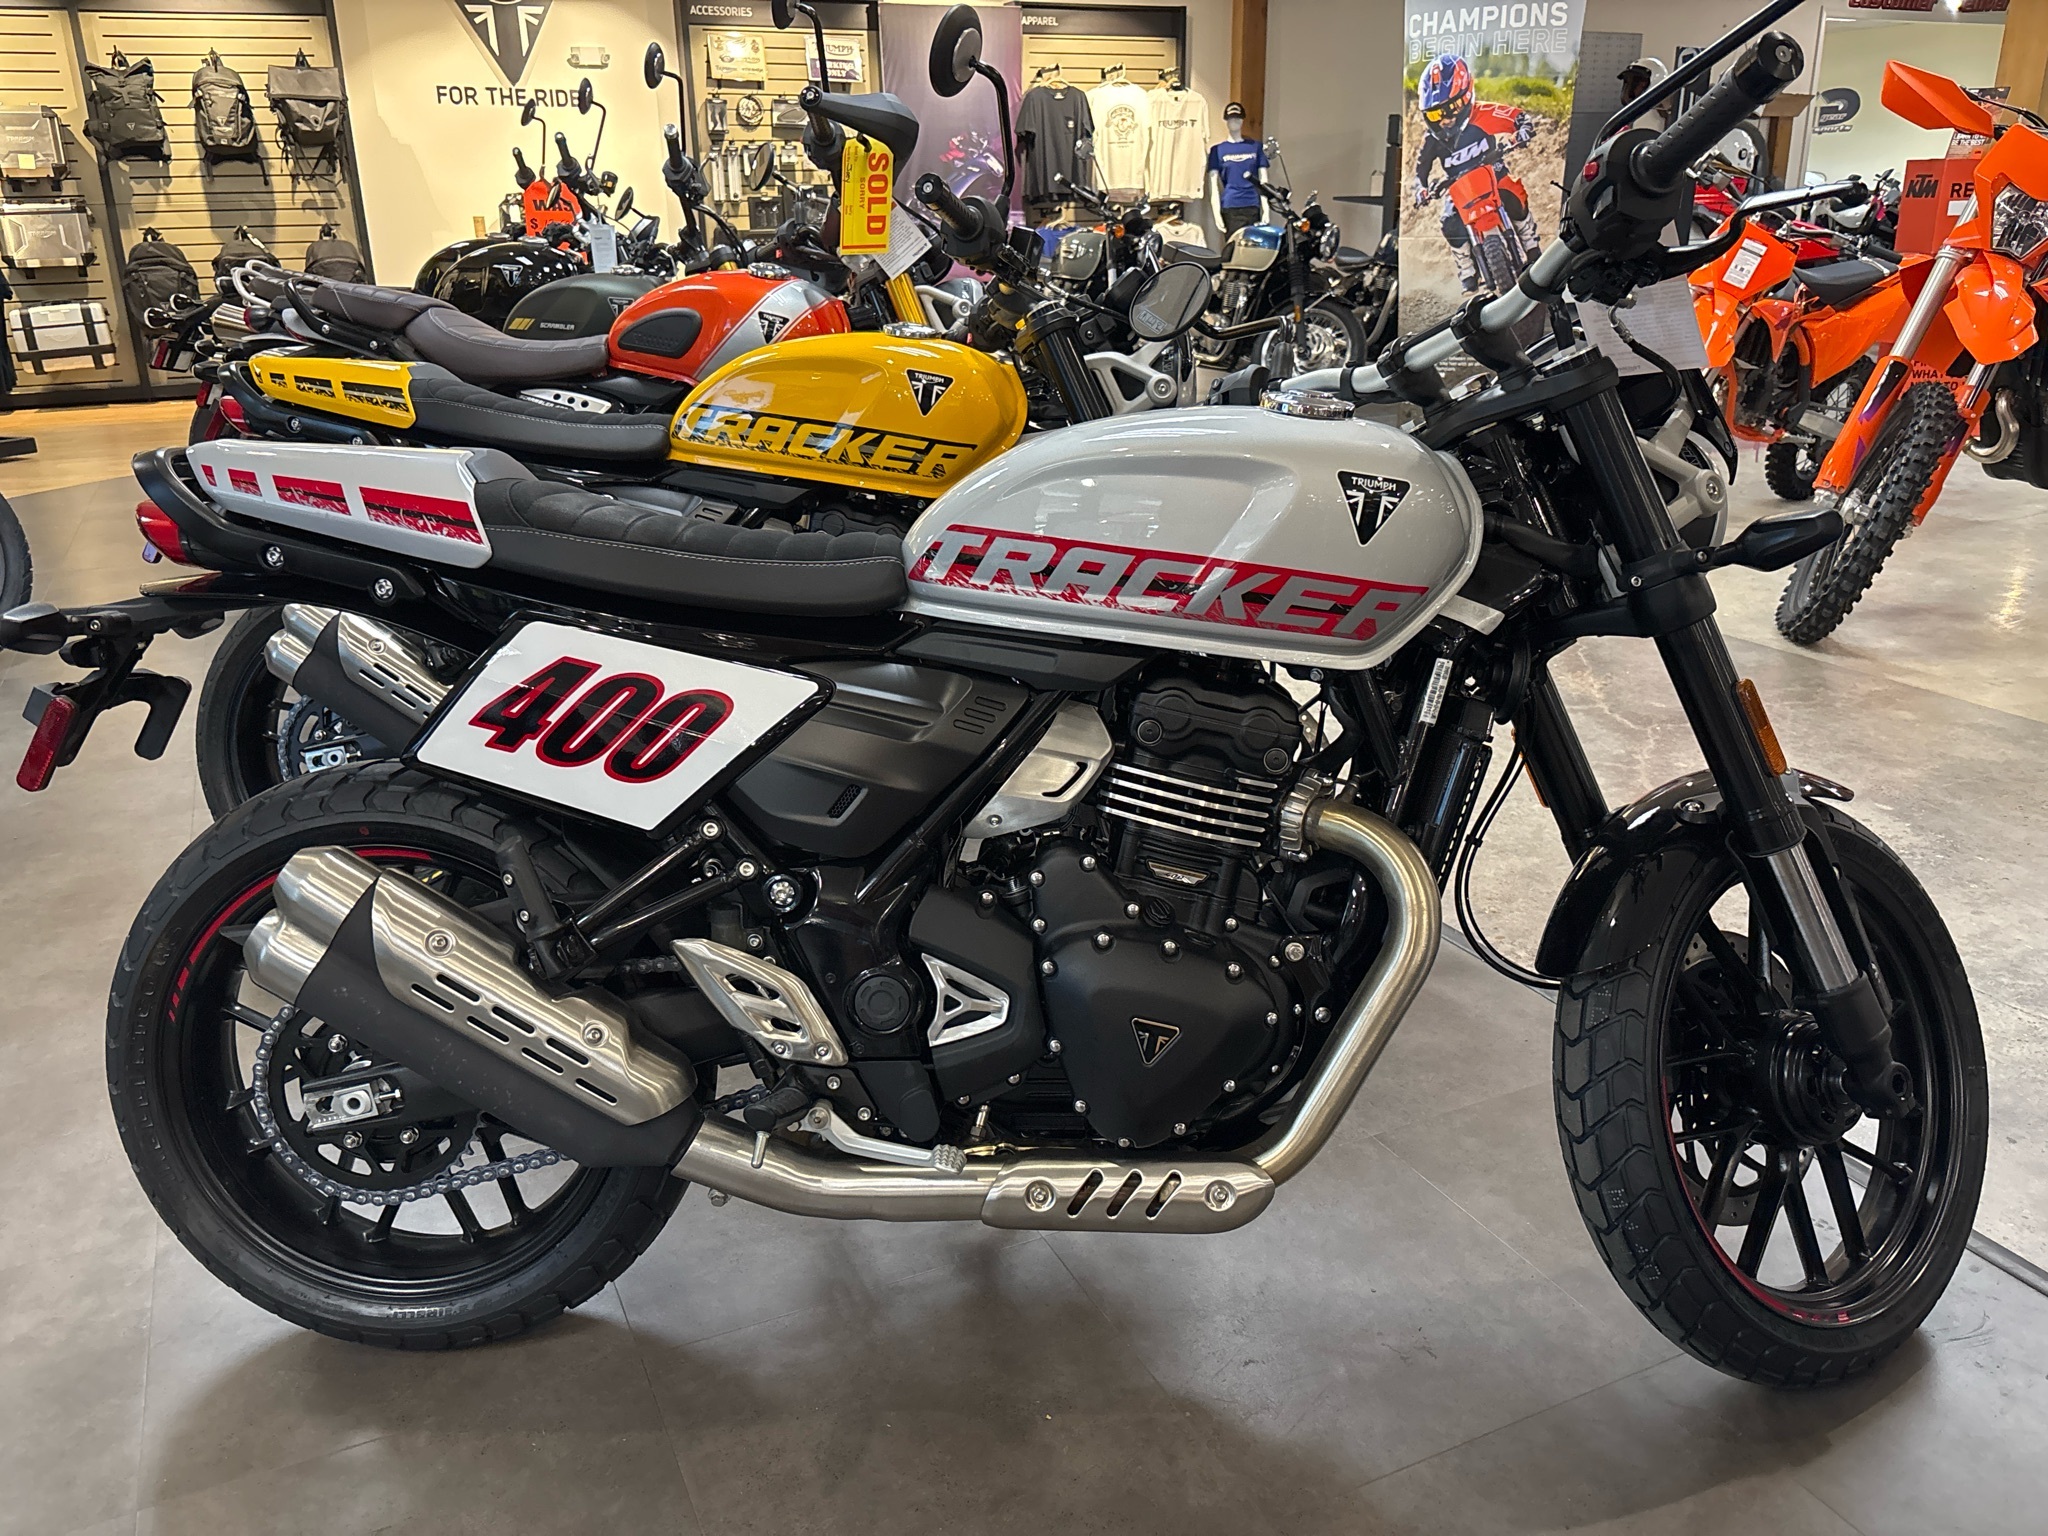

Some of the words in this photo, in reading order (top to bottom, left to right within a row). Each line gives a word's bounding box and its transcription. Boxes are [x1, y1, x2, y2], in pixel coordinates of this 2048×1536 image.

[689, 5, 753, 17] ACCESSORIES
[1020, 16, 1059, 26] APPAREL
[1408, 1, 1569, 39] CHAMPIONS
[1408, 32, 1484, 64] BEGIN
[1492, 28, 1568, 56] HERE
[436, 85, 479, 106] FOR
[485, 87, 527, 106] THE
[535, 89, 580, 108] RIDE
[1444, 137, 1490, 168] KTM
[867, 152, 890, 236] SOLD
[1905, 174, 1939, 199] KTM
[539, 322, 575, 331] SCRAMBLER
[914, 372, 945, 385] TRIUMPH
[678, 404, 976, 478] TRACKER
[1351, 476, 1397, 493] TRIUMPH
[928, 531, 1425, 639] TRACKER
[468, 655, 735, 784] 400
